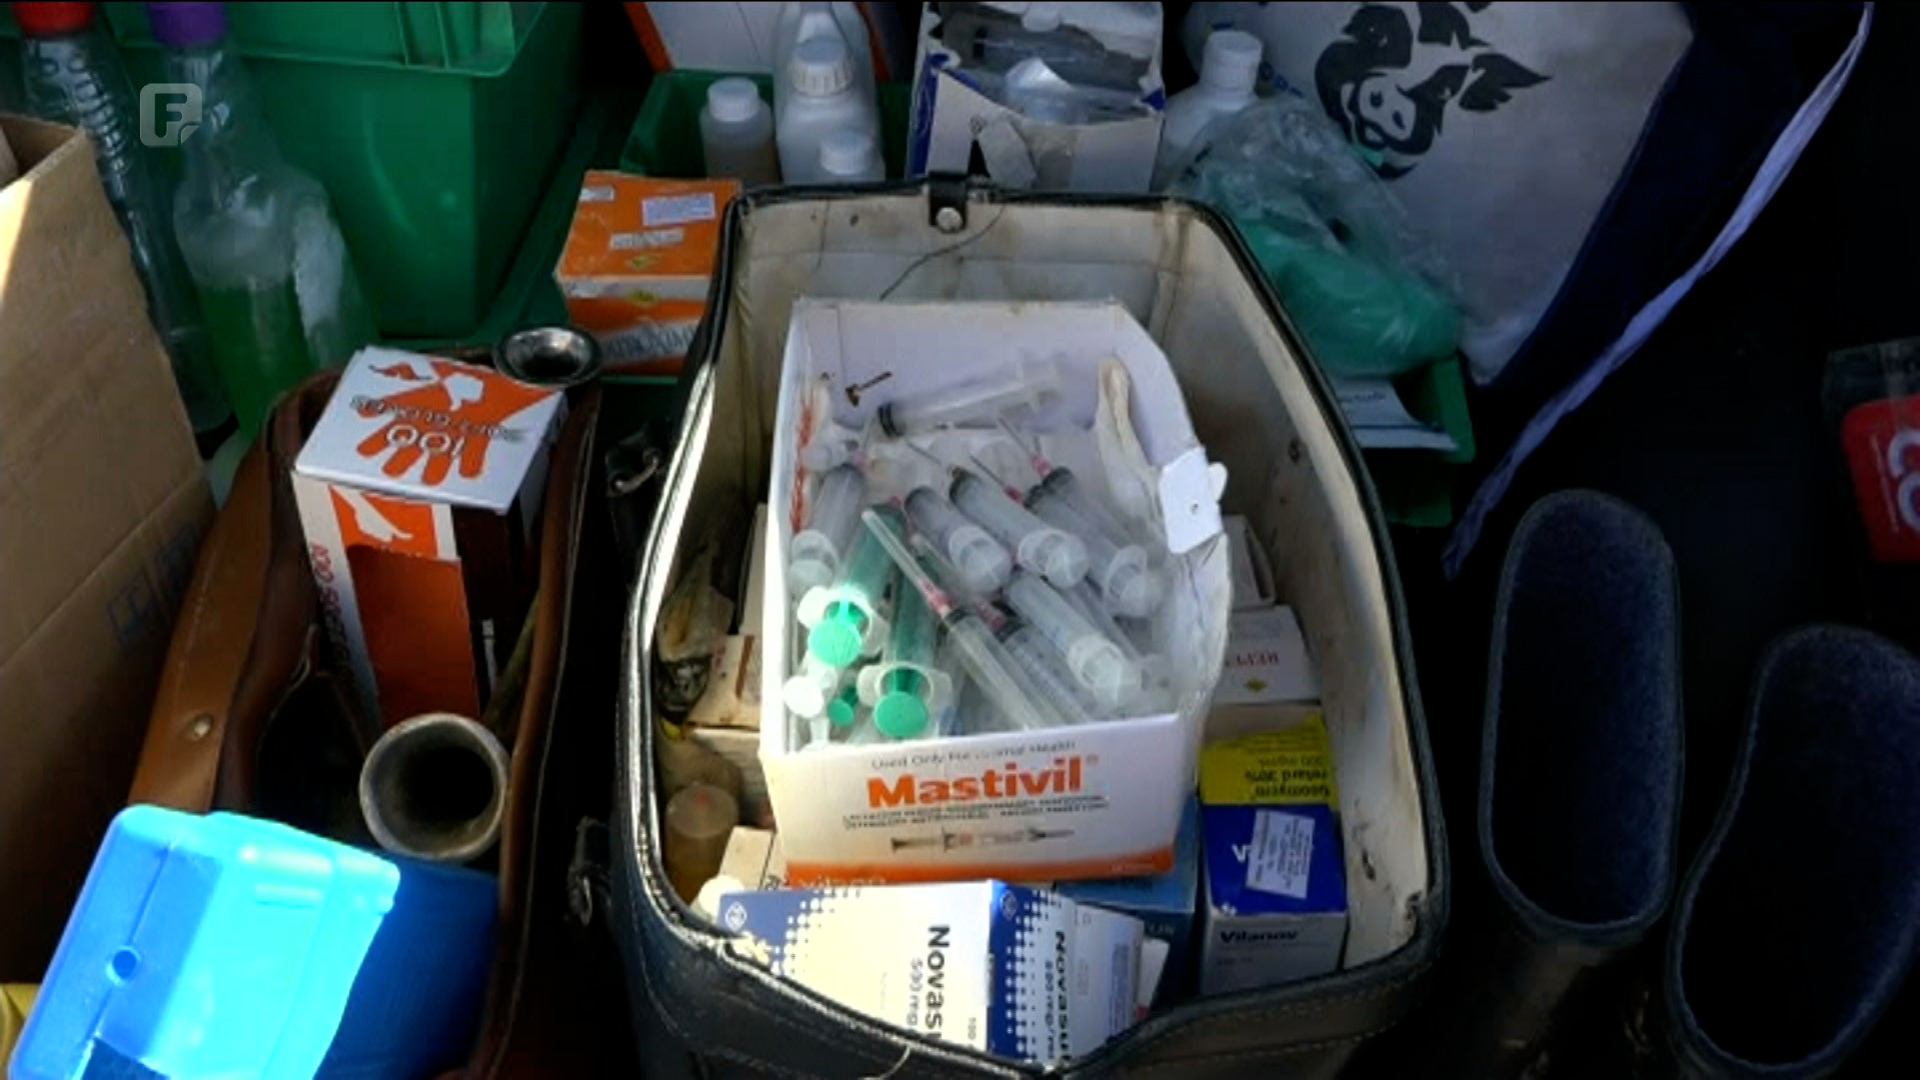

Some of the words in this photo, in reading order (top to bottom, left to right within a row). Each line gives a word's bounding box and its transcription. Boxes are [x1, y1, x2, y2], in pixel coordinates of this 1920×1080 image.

[386, 424, 466, 458] 100
[911, 752, 946, 768] Only
[867, 756, 1081, 808] Mastivil
